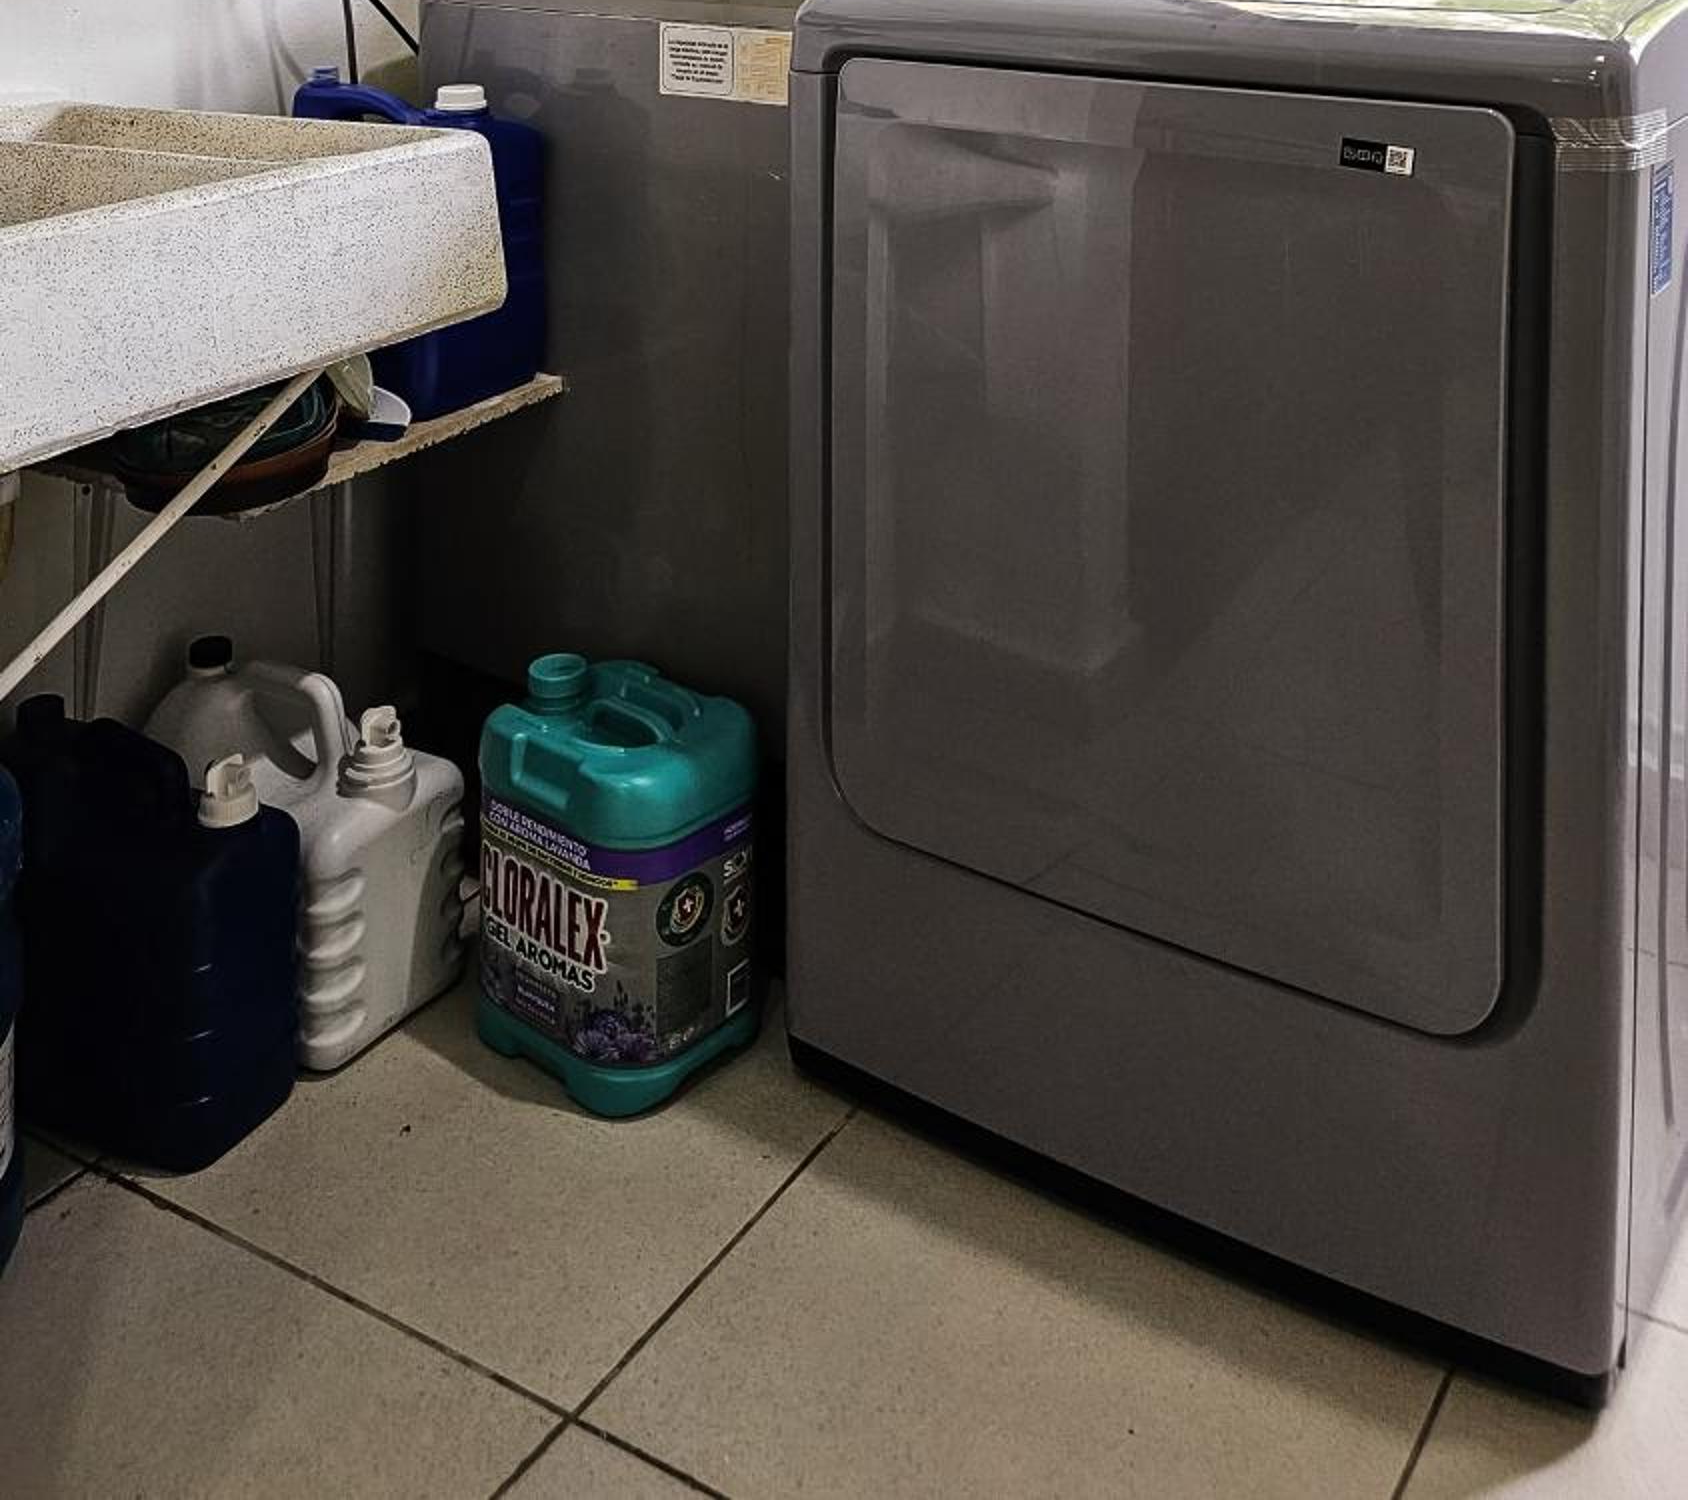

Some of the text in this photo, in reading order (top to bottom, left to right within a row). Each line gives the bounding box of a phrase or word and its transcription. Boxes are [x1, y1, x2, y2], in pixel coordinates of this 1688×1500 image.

[510, 822, 543, 847] AROMA
[545, 840, 591, 871] LAVANDA
[482, 842, 606, 971] CLORALEX
[486, 918, 593, 991] GEL AROMAS
